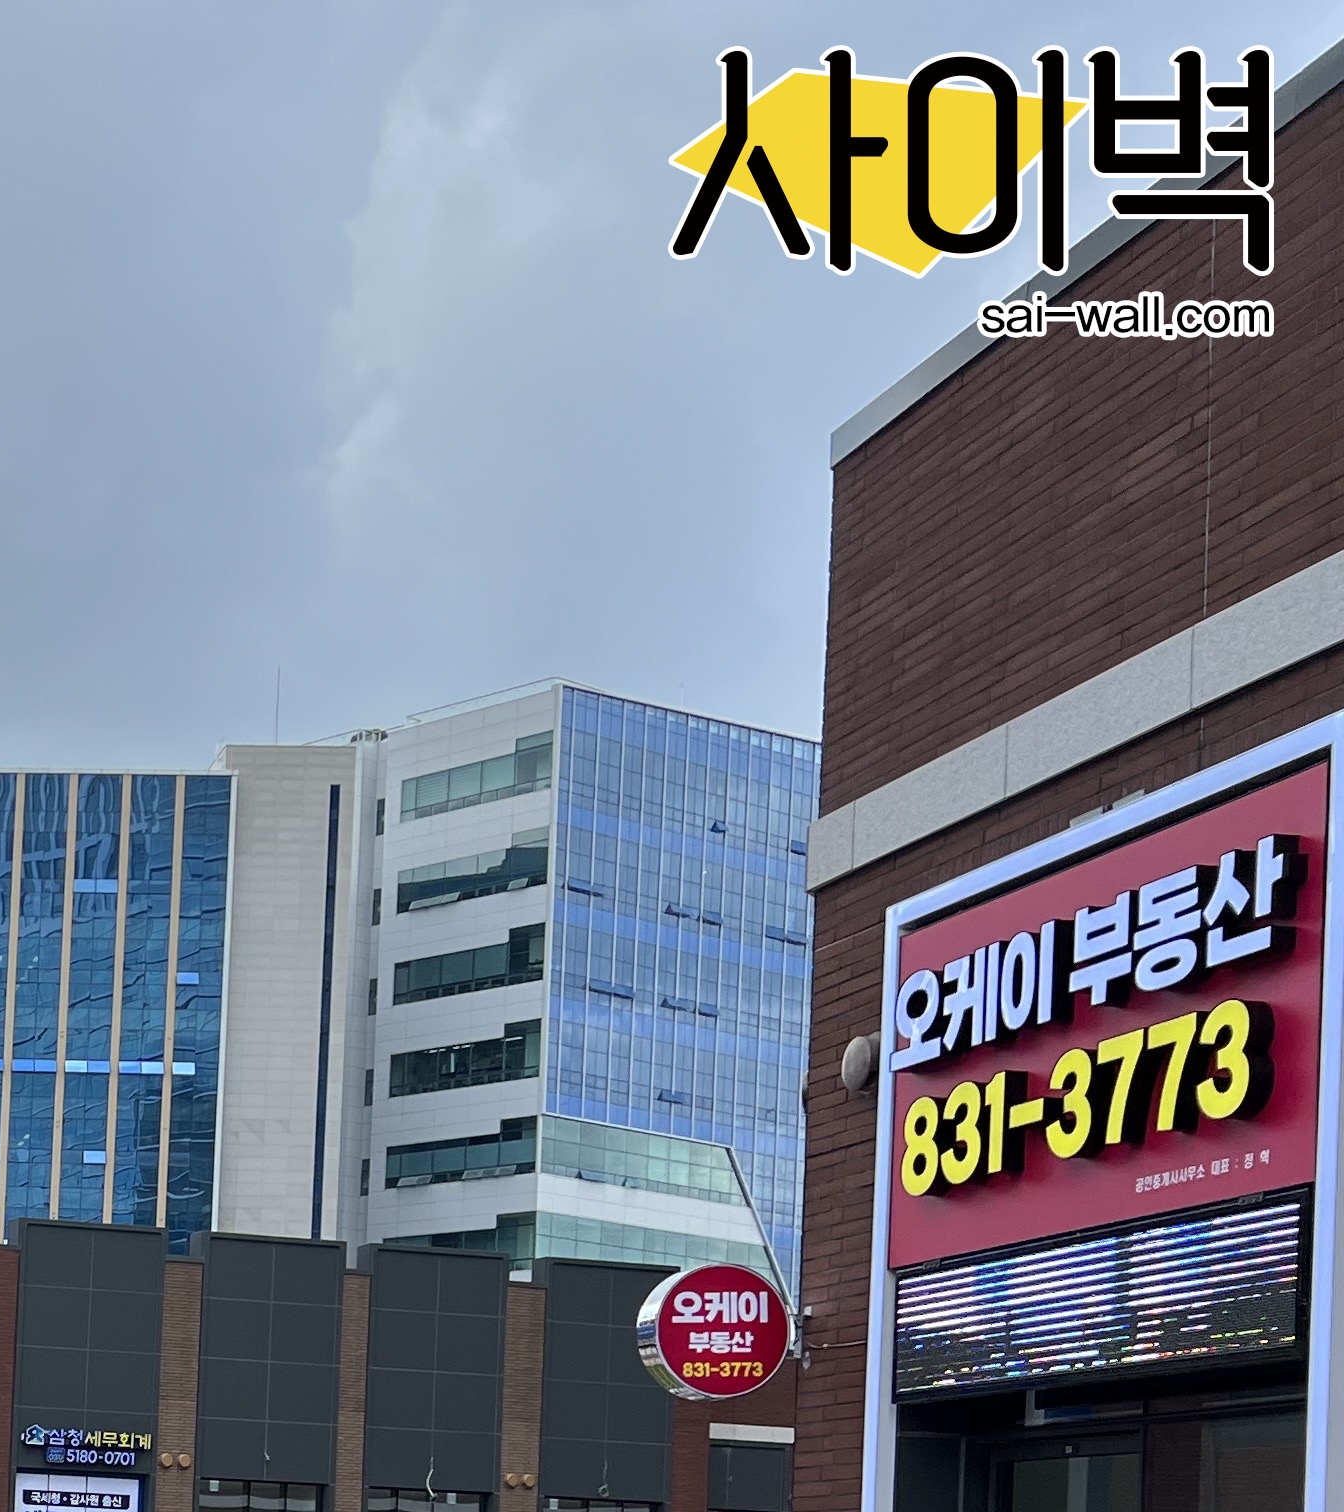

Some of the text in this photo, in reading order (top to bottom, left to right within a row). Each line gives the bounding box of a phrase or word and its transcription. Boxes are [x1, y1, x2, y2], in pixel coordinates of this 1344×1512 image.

[889, 833, 1286, 1074] 오케이 부동산
[900, 998, 1253, 1199] 831-3773
[1210, 1157, 1231, 1176] 대표
[671, 1291, 769, 1324] 오케이
[688, 1331, 755, 1354] 부동산
[681, 1362, 764, 1378] 831-3773
[66, 1448, 136, 1466] 5180-0701
[30, 1491, 61, 1505] 국세청
